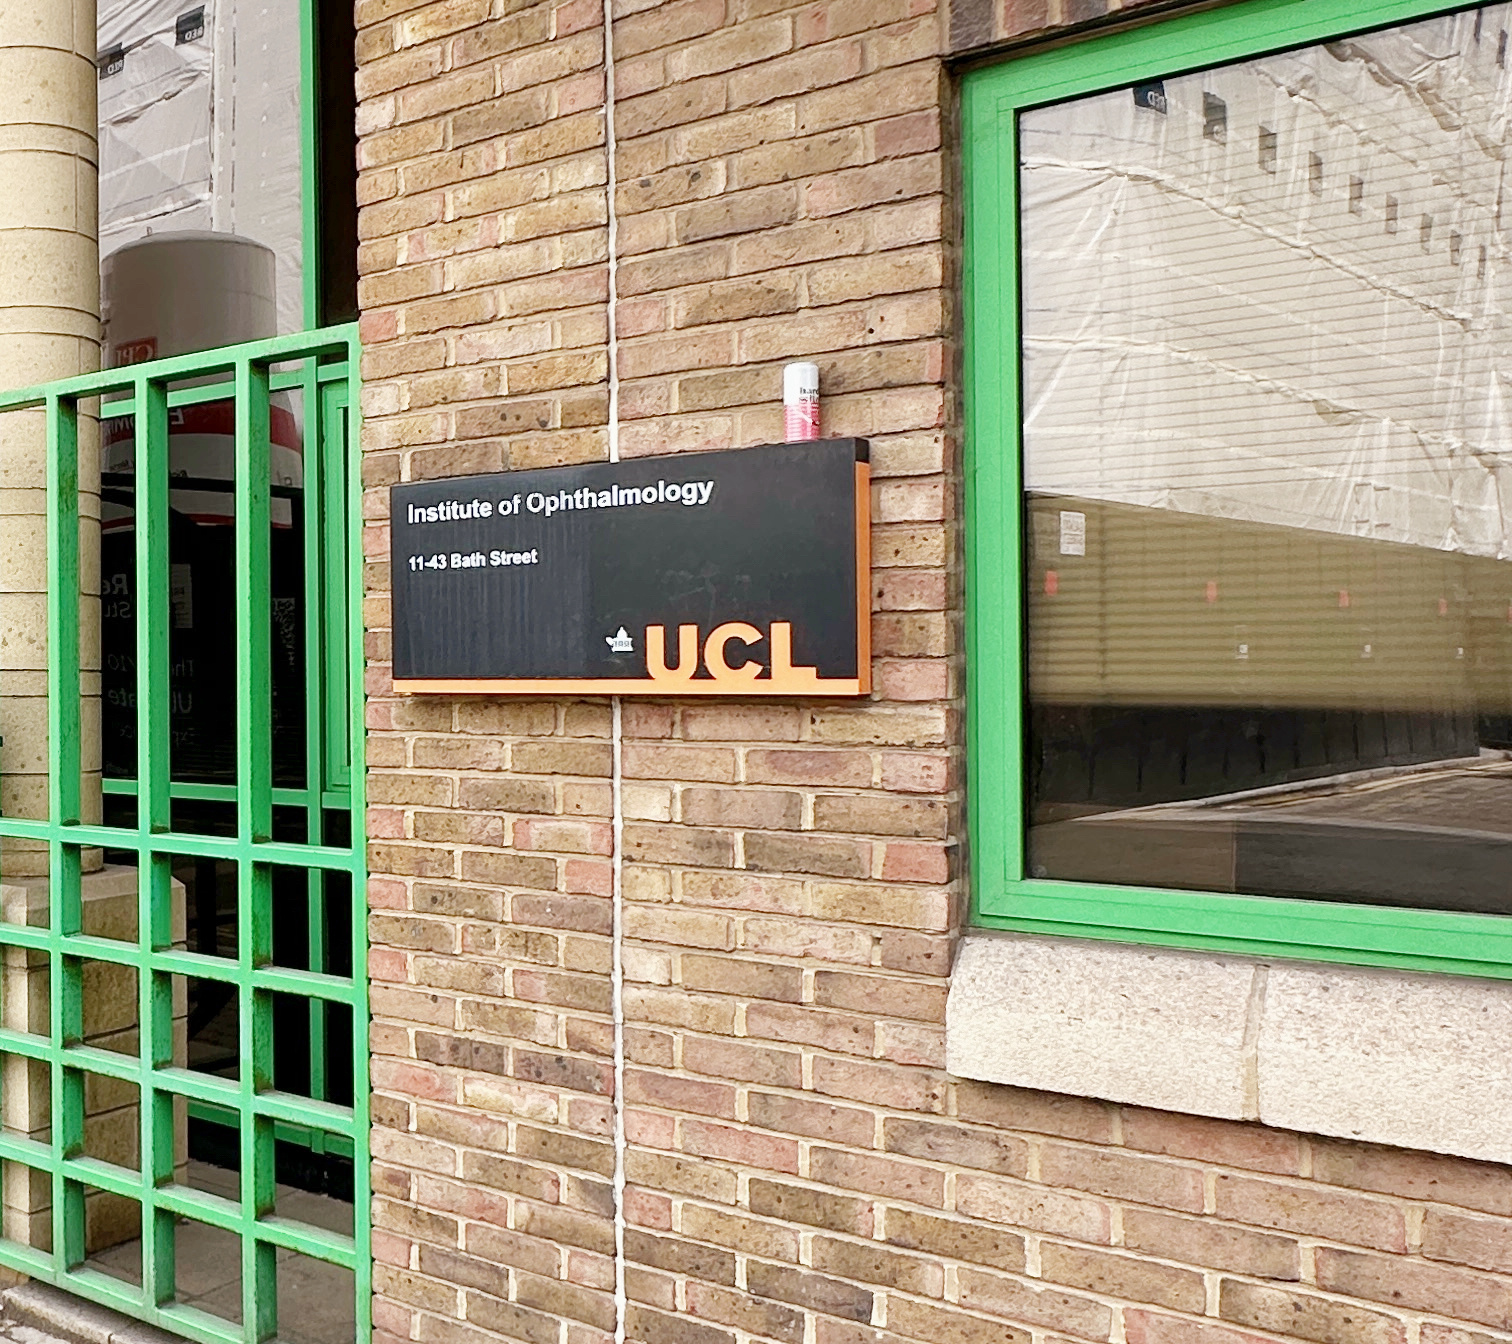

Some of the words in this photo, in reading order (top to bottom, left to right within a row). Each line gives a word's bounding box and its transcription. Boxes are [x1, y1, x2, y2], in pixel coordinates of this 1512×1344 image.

[408, 498, 494, 524] Institute
[498, 493, 522, 516] of
[526, 480, 715, 517] Ophthalmology
[408, 554, 448, 572] 11-43
[450, 551, 487, 569] Bath
[490, 548, 539, 567] Street
[645, 622, 817, 680] UCL
